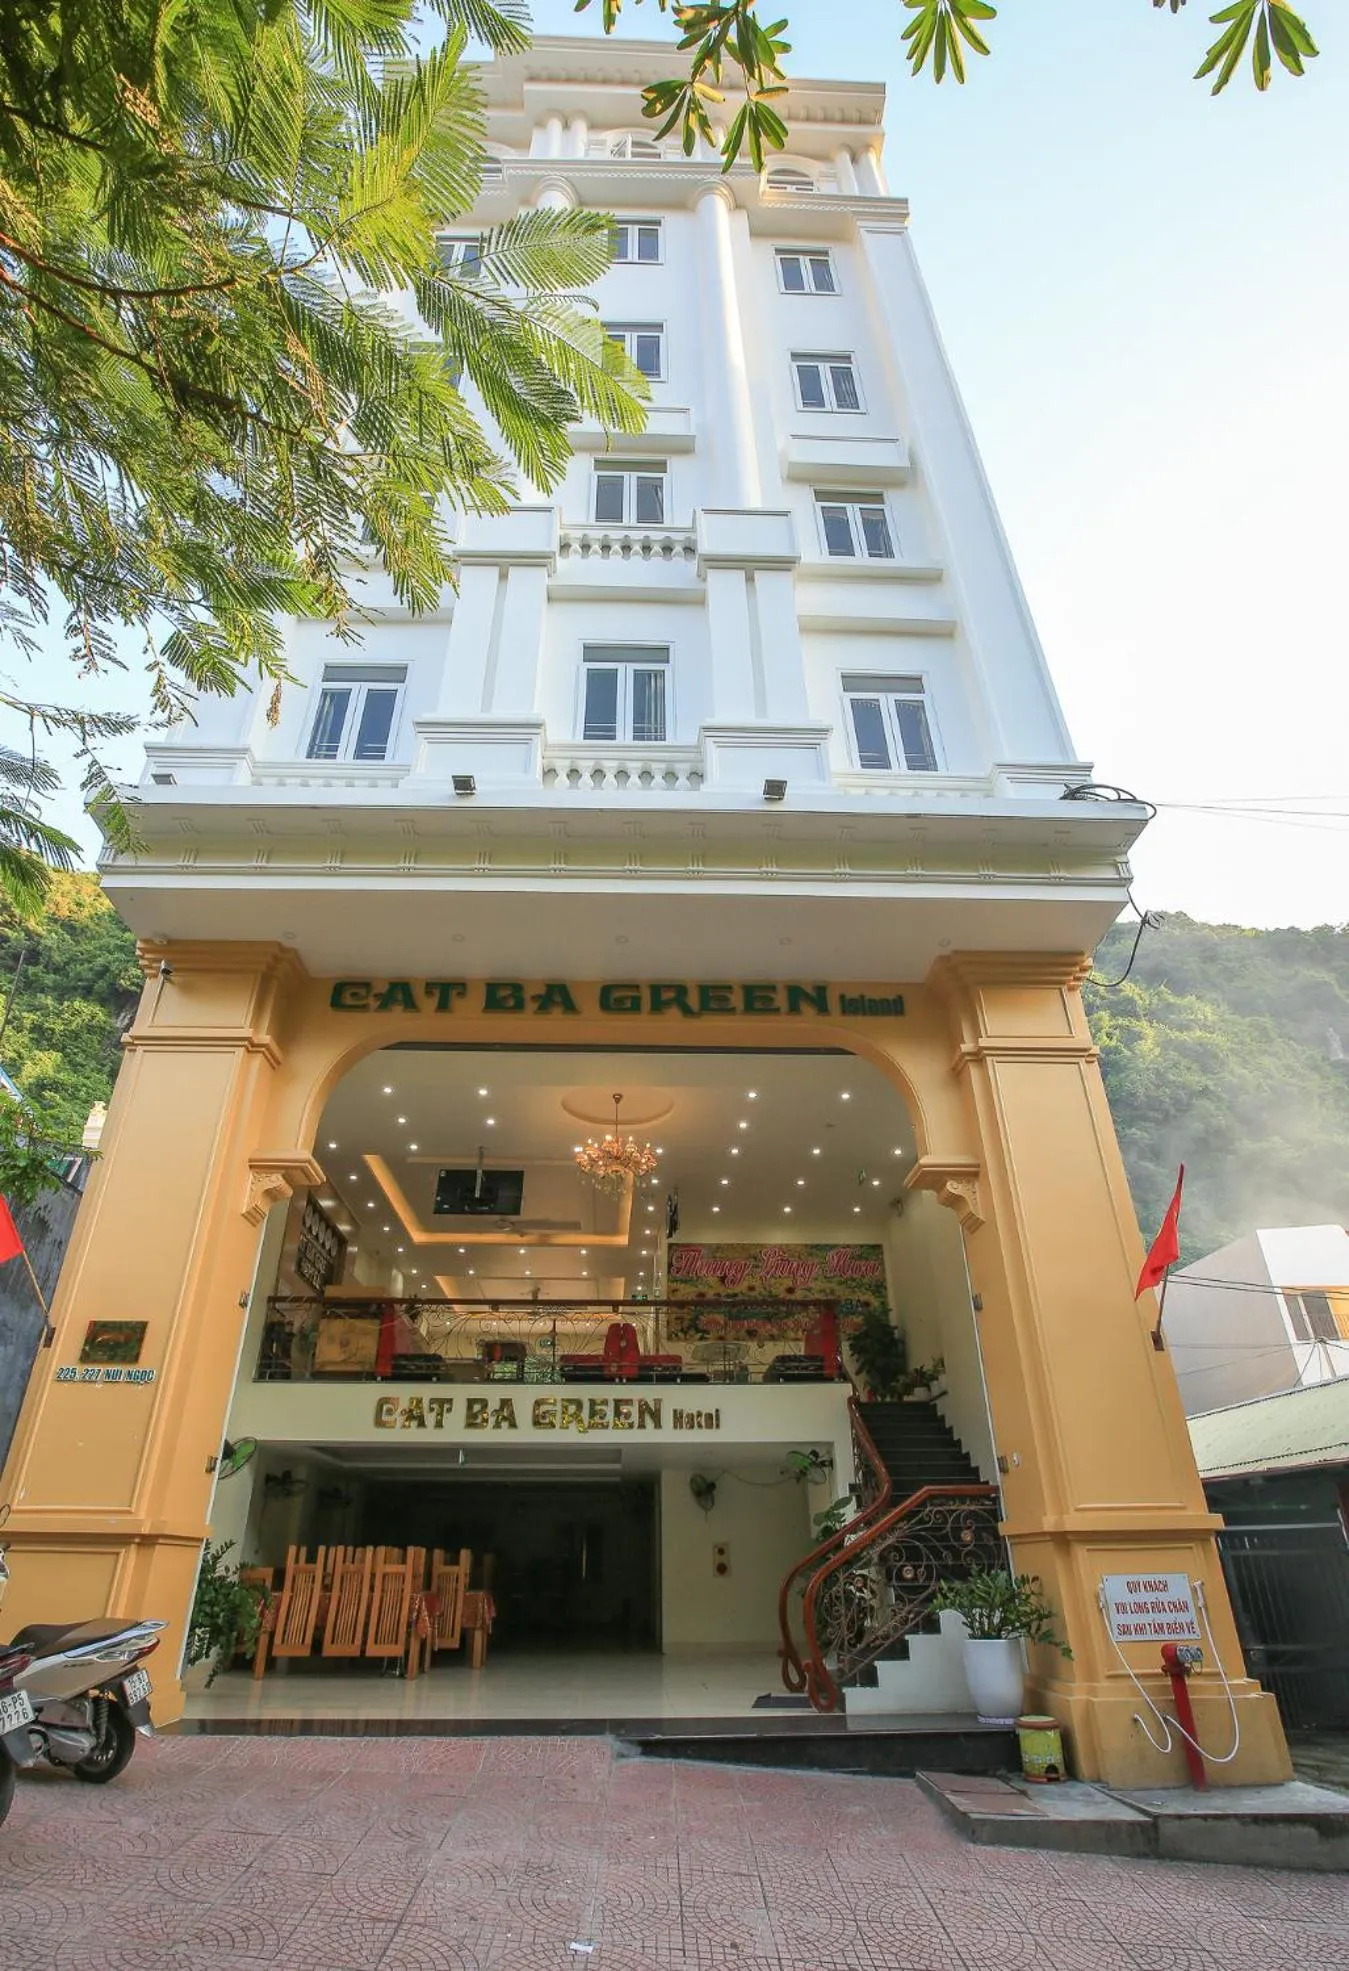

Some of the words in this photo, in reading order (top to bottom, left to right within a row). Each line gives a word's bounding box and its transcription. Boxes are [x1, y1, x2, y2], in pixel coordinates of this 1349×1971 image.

[330, 981, 468, 1013] CAT
[482, 982, 581, 1015] BA
[599, 983, 832, 1018] GREEN
[82, 1368, 101, 1381] 227
[373, 1397, 453, 1430] CAT
[464, 1397, 519, 1430] BA
[532, 1396, 663, 1434] GREEN
[672, 1408, 721, 1431] Hotel
